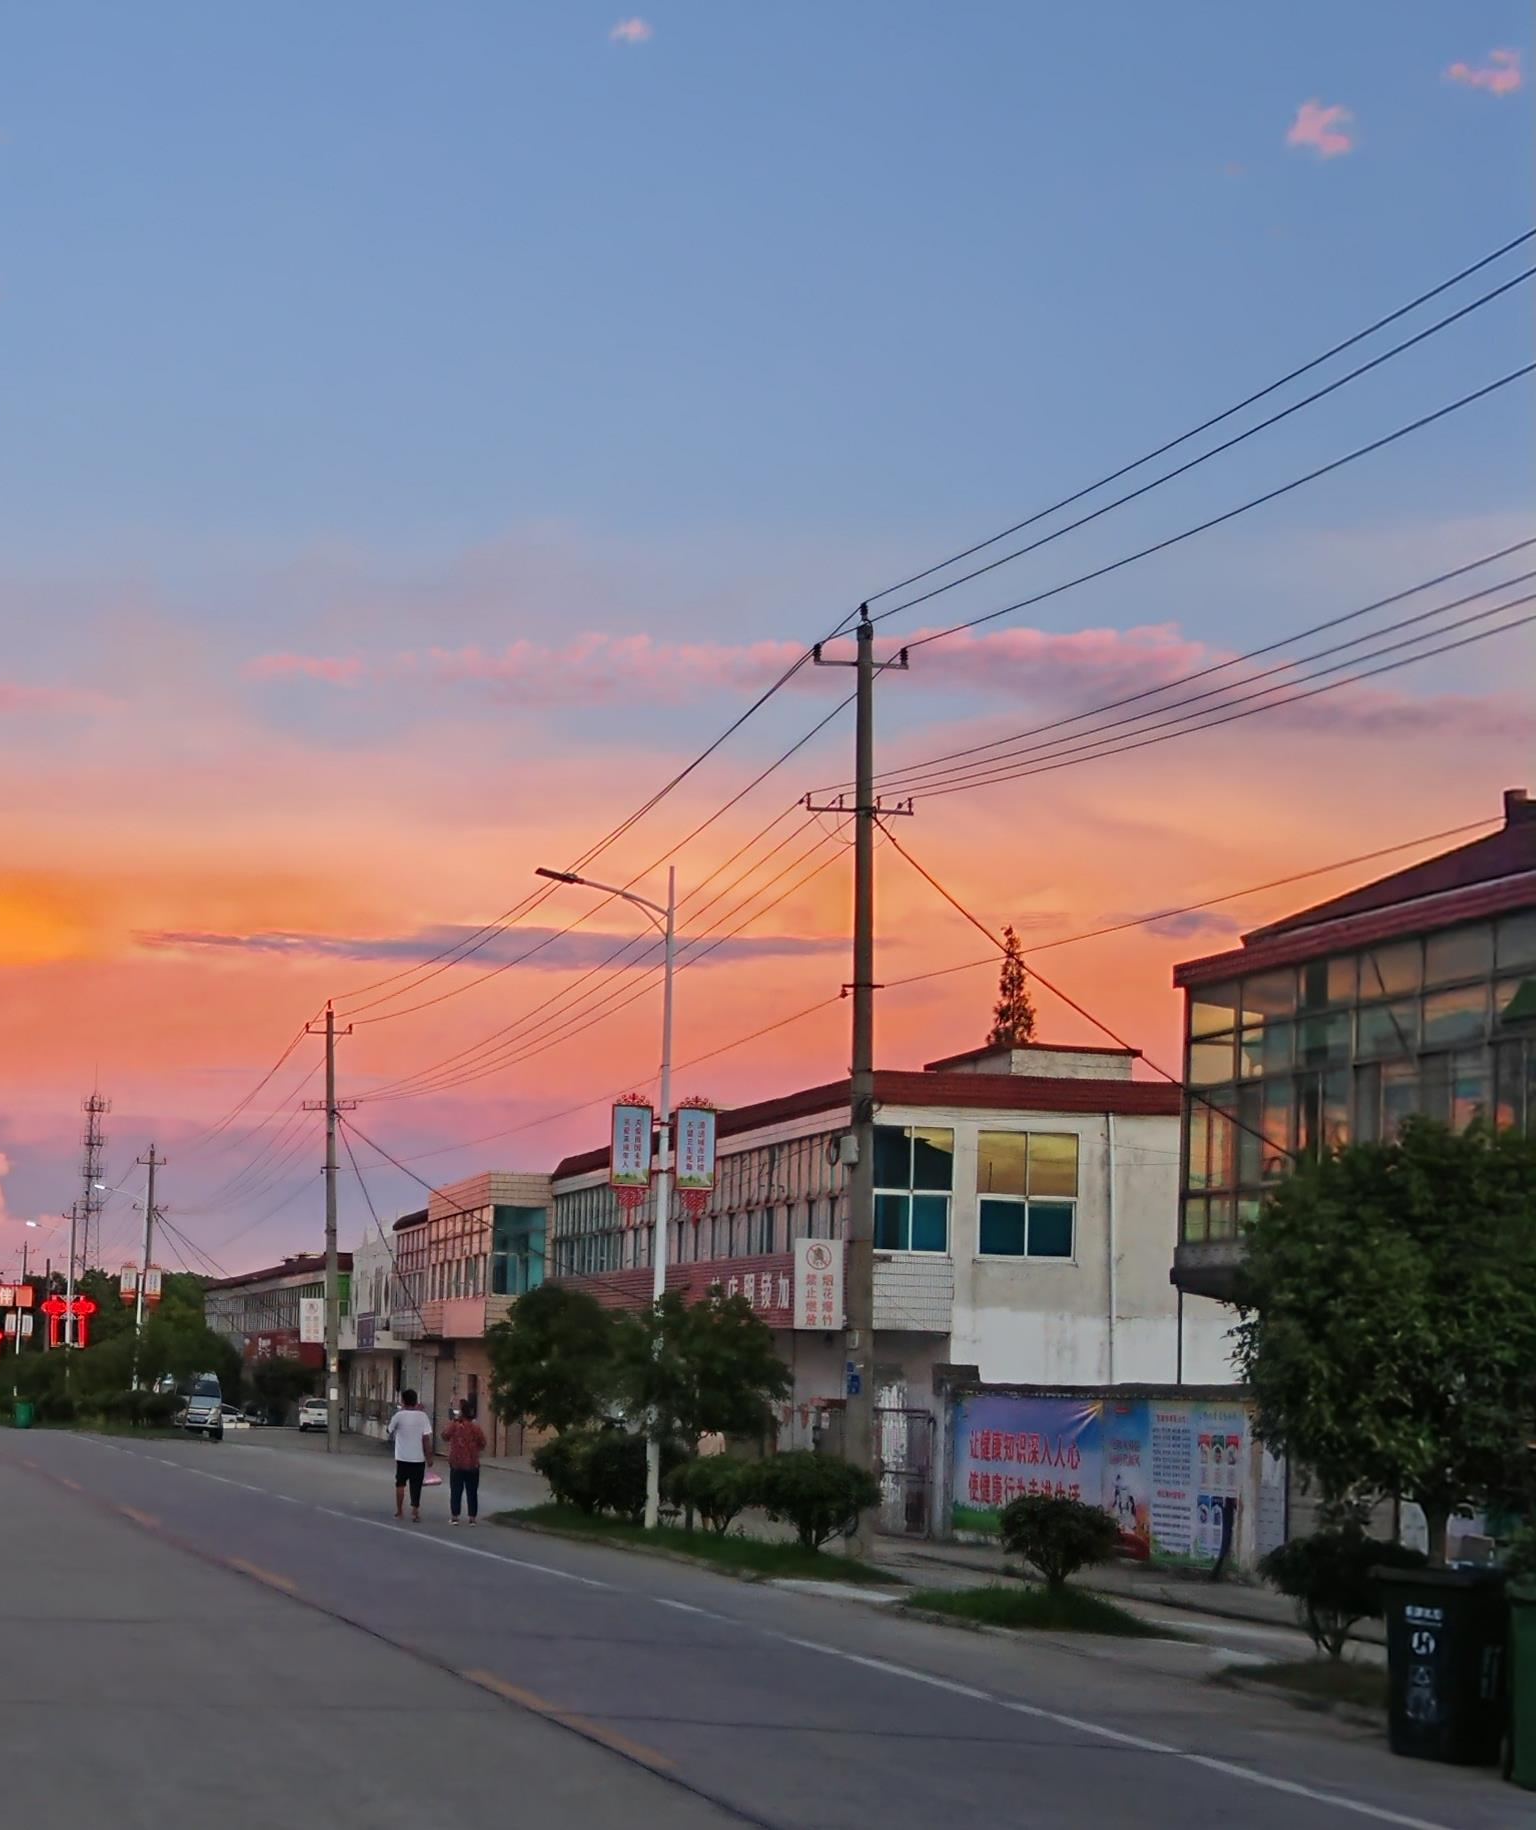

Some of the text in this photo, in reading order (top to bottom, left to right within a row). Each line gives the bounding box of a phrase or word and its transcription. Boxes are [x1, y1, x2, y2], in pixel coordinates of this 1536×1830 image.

[806, 1274, 817, 1326] 禁止燃放
[822, 1274, 834, 1326] 烟花爆竹
[969, 1429, 1081, 1470] 让健康知识深入人心
